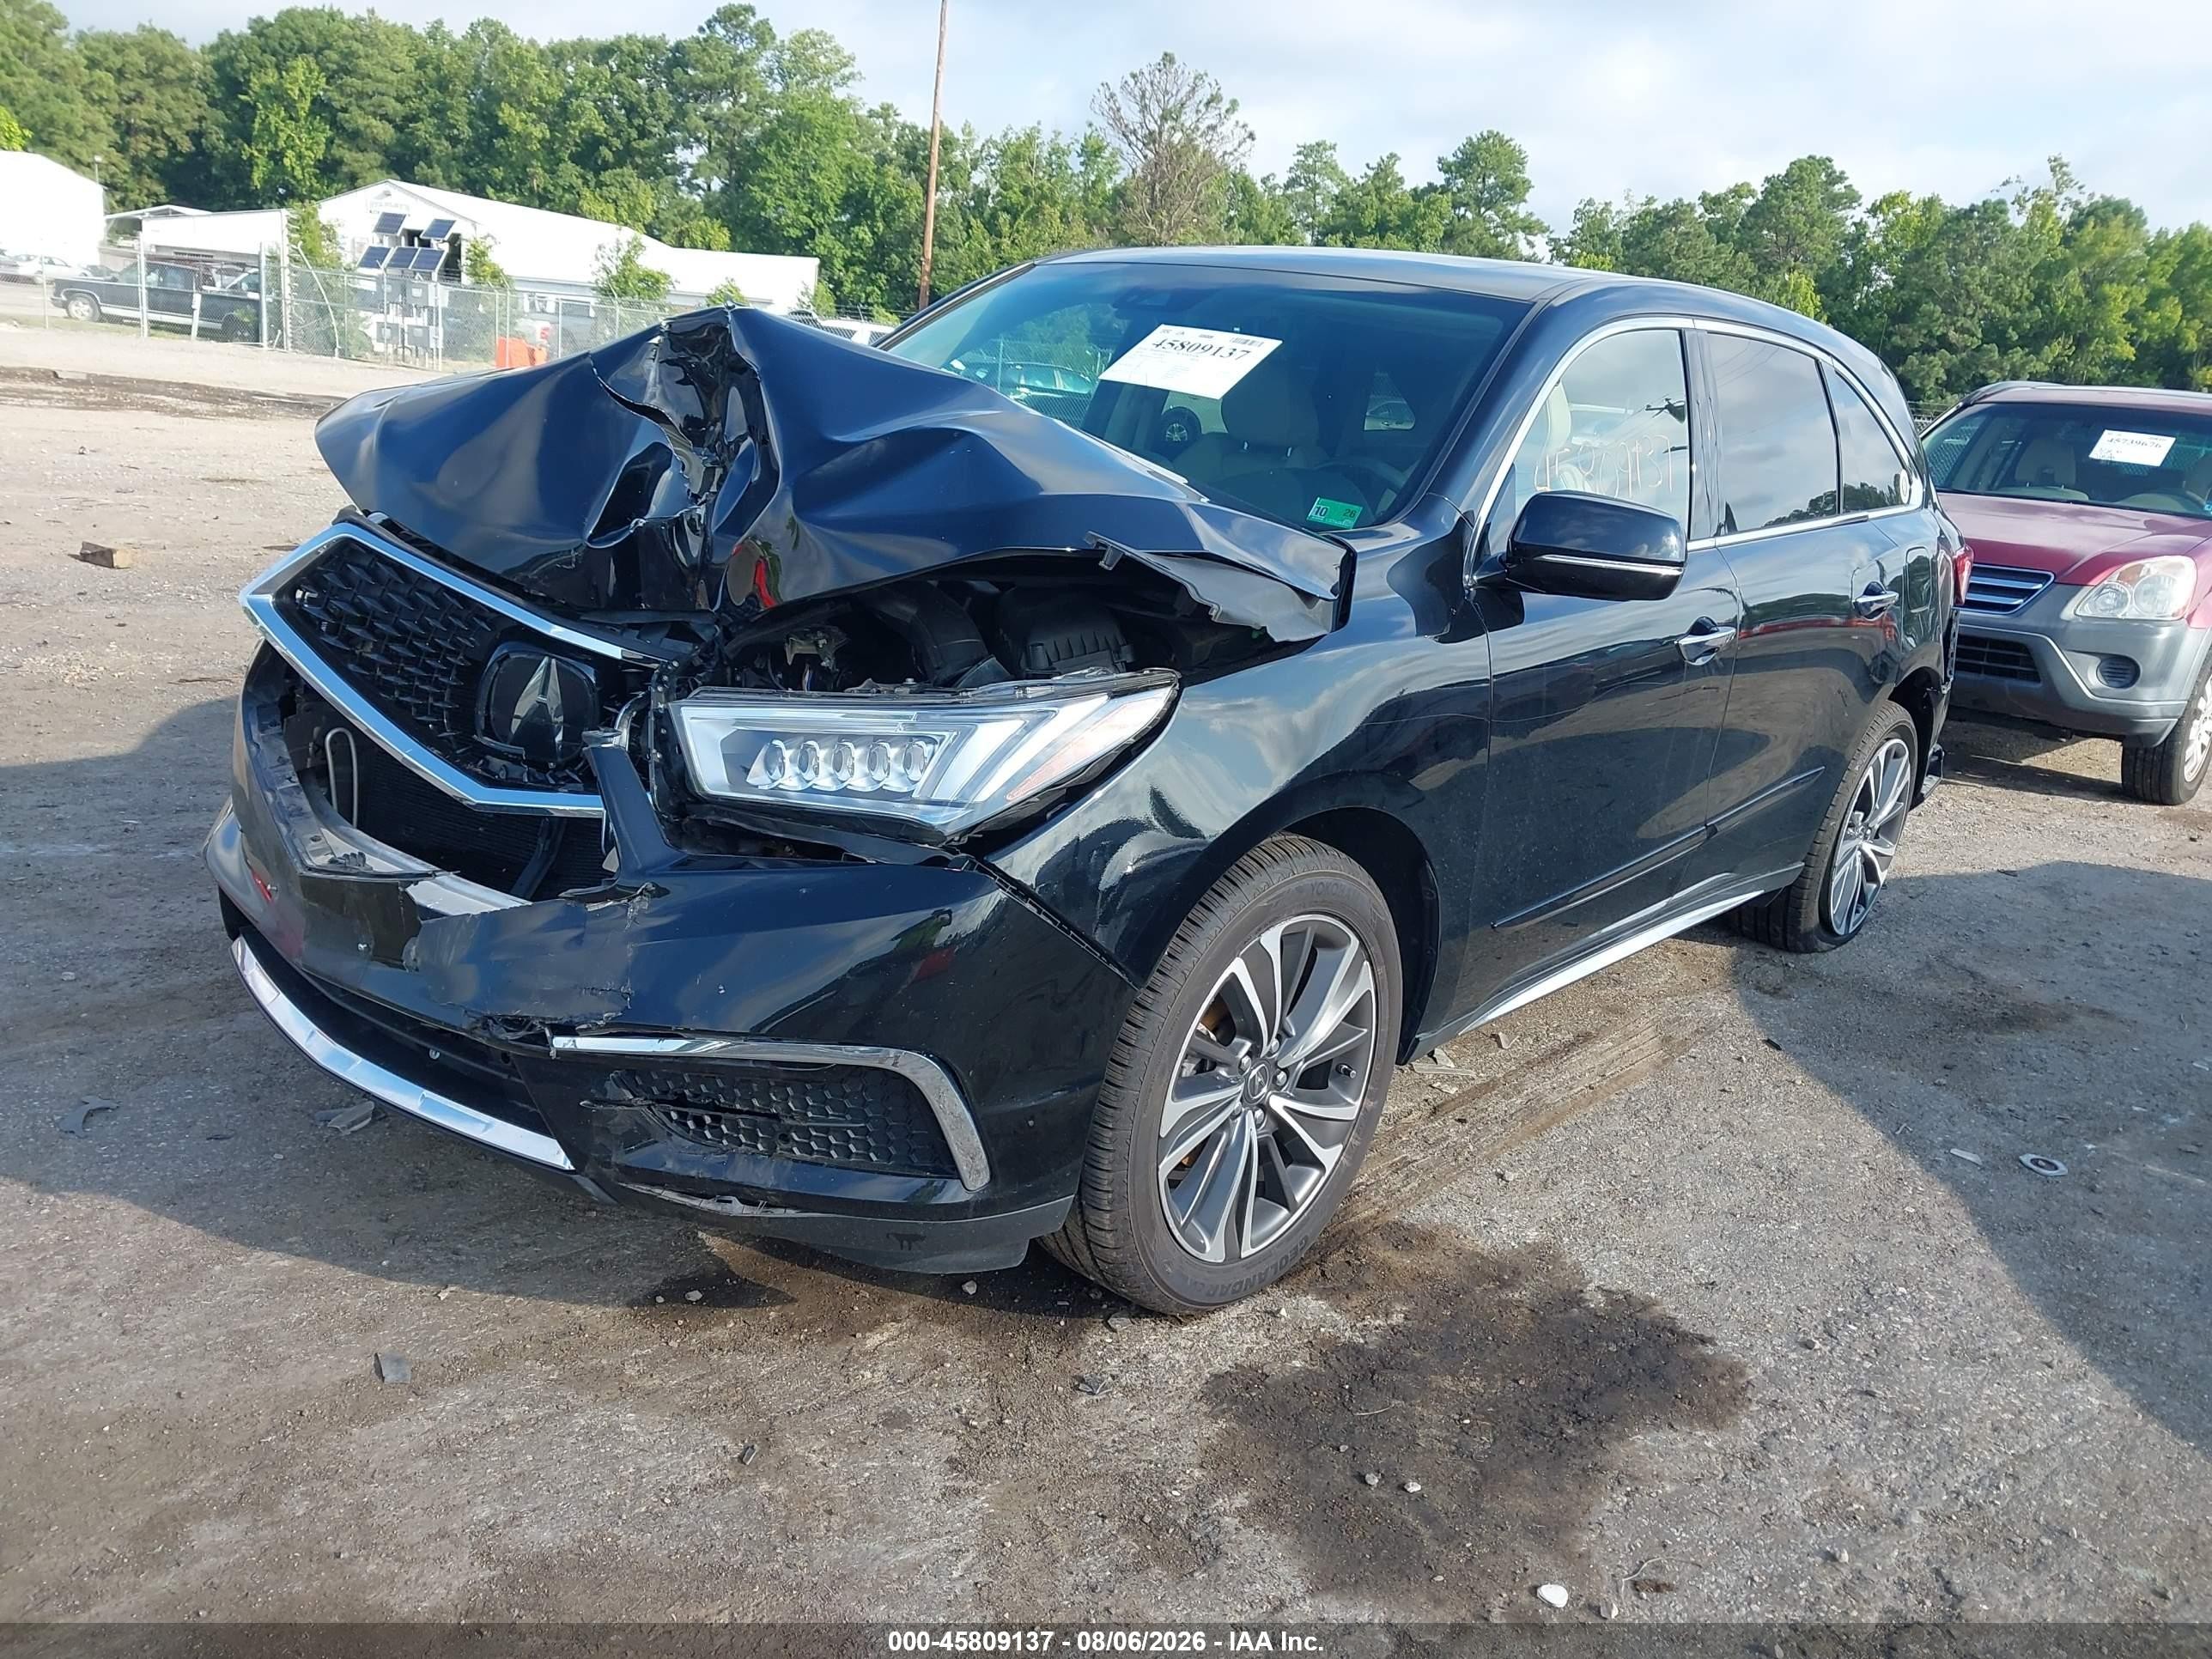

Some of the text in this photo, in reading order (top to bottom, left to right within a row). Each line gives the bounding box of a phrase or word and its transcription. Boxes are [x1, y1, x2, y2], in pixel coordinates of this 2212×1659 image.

[1152, 338, 1251, 361] 45809137
[1314, 506, 1357, 519] 10 26
[1205, 1234, 1310, 1297] GEOLANDAR
